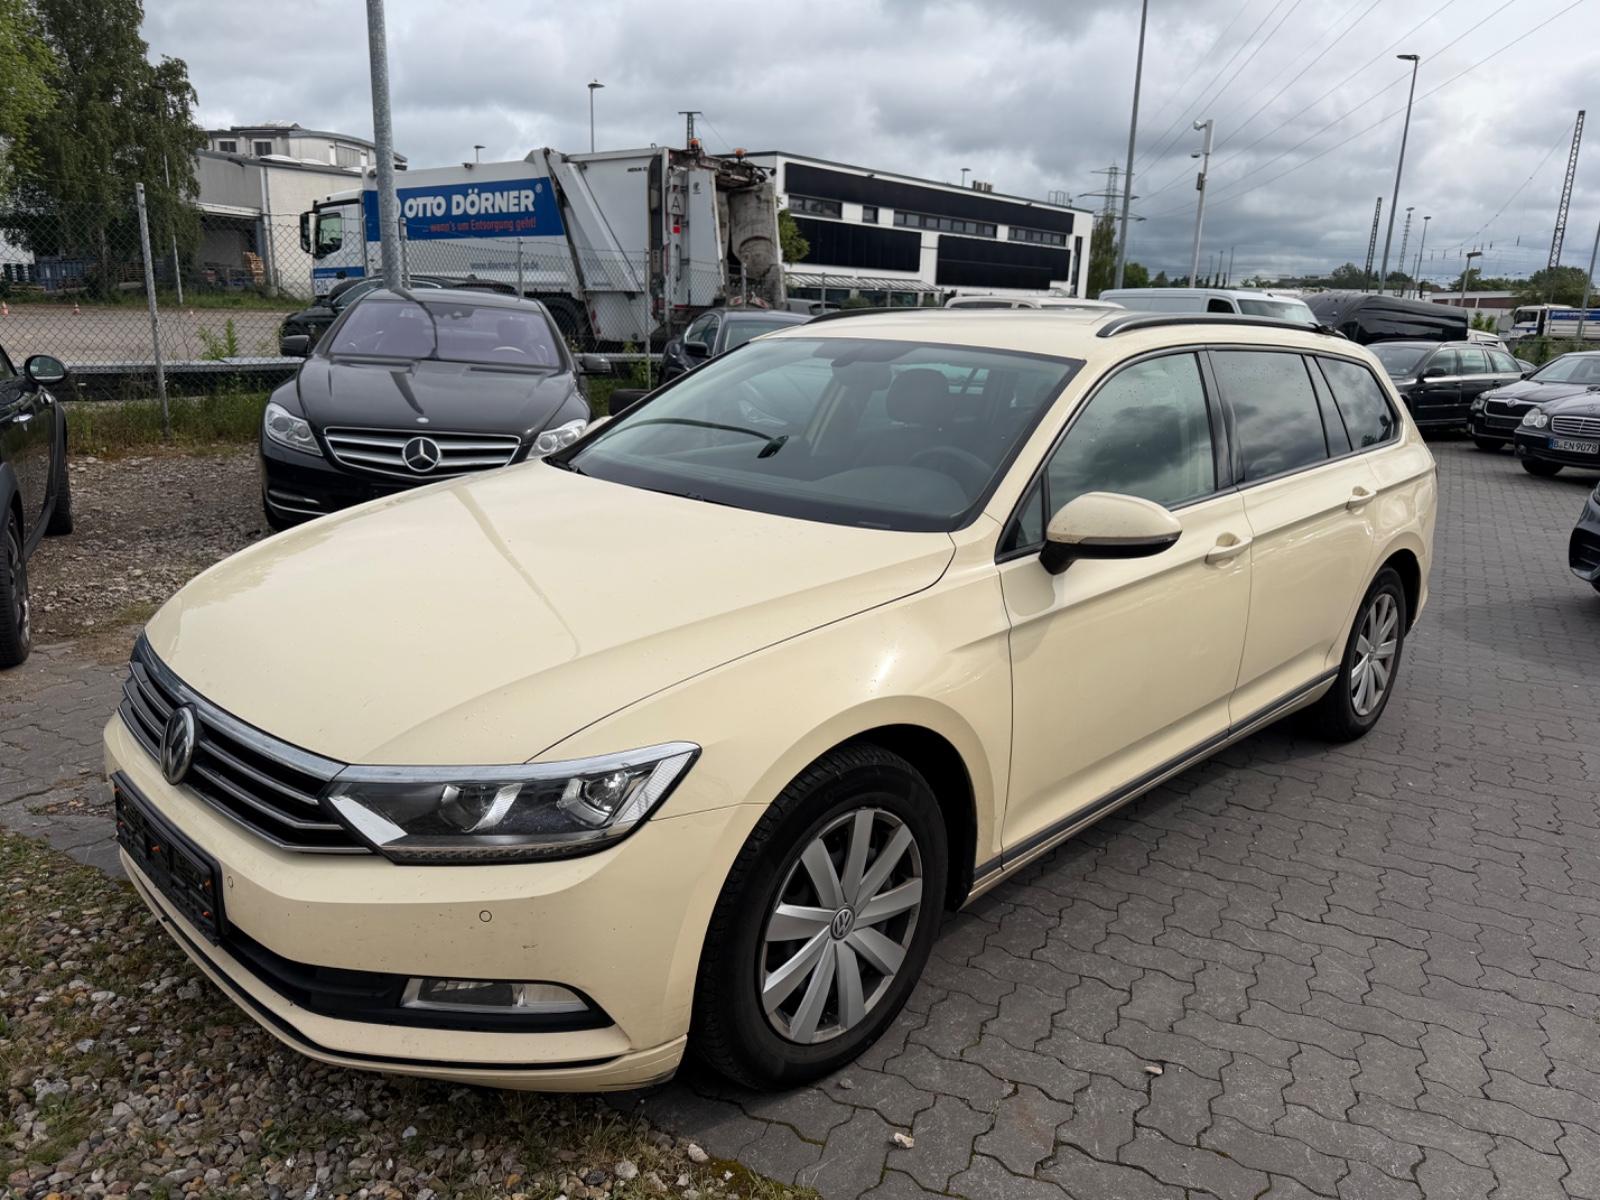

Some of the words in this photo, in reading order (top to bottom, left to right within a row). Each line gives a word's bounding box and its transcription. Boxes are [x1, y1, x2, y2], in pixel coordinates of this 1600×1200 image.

[404, 196, 446, 218] OTTO
[452, 188, 535, 216] DÖRNER
[671, 195, 681, 210] A
